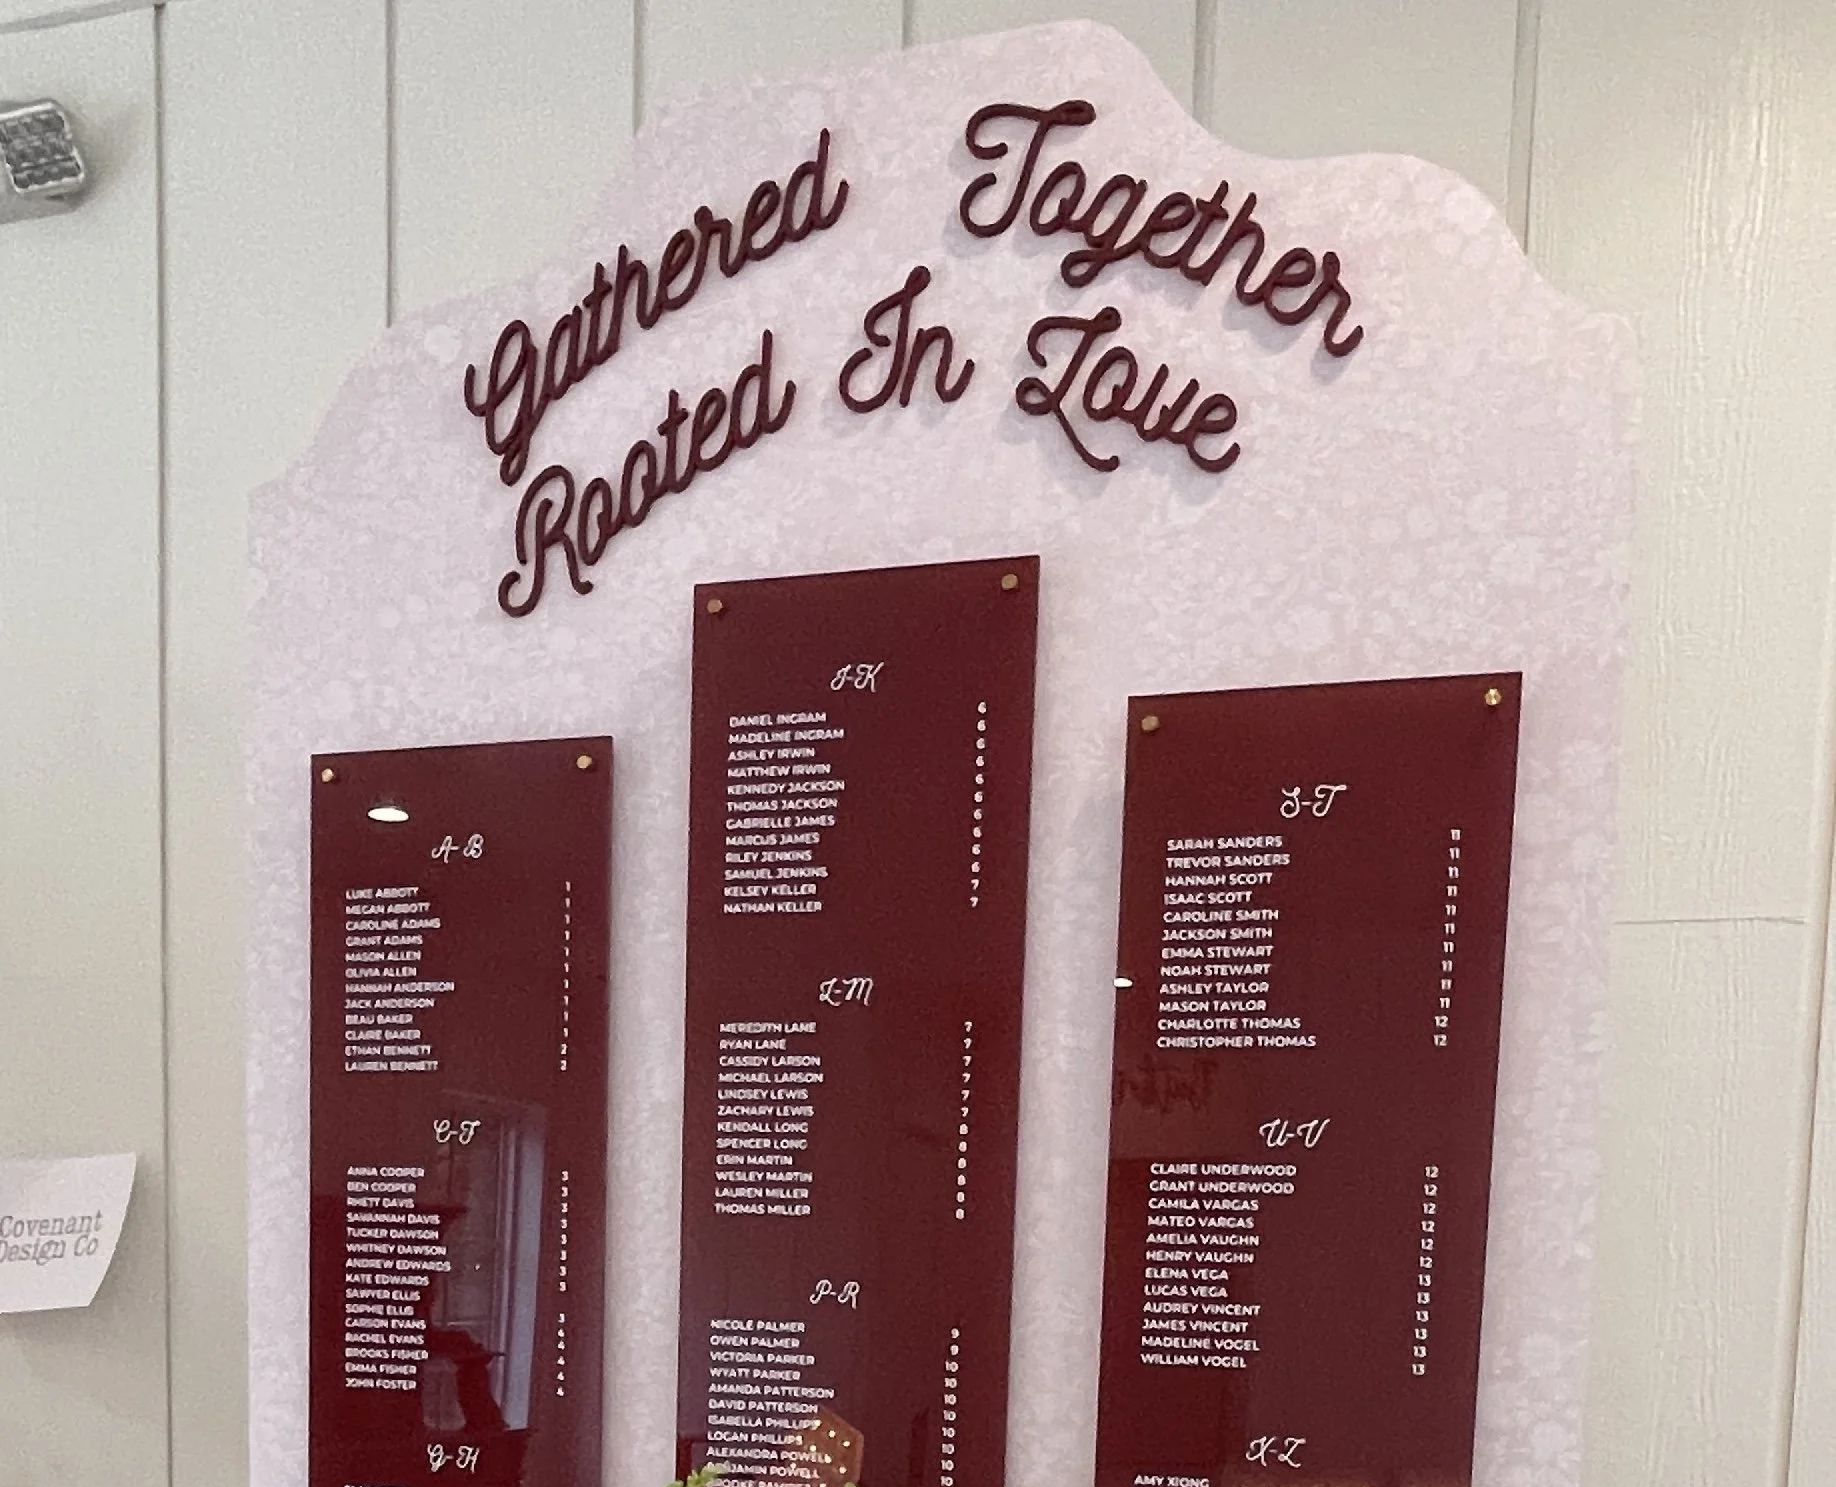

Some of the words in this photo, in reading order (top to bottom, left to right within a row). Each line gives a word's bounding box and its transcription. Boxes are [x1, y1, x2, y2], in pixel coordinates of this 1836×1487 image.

[464, 127, 849, 486] Gathered
[959, 99, 1364, 357] Together
[498, 328, 797, 618] Rooted
[838, 265, 975, 414] In
[1015, 306, 1241, 473] Love
[729, 714, 776, 728] DANIEL
[775, 712, 826, 725] INGRAM
[728, 730, 793, 744] MADELINE
[794, 729, 844, 740] INGRAM
[728, 765, 791, 778] MATTHEW
[792, 764, 831, 776] IRWIN
[727, 782, 787, 795] KENNEDY
[786, 780, 845, 793] JACKSON
[726, 800, 781, 812] THOMAS
[780, 797, 838, 810] JACKSON
[1167, 838, 1214, 851] SARAH
[1217, 836, 1282, 849] SANDERS
[1166, 855, 1222, 869] TREVOR
[1224, 854, 1290, 867] SANDERS
[1165, 874, 1226, 887] HANNAH
[1229, 872, 1273, 886] SCOTT
[724, 884, 771, 897] KELSEY
[770, 884, 816, 896] KELLER
[1164, 892, 1207, 905] ISAAC
[1206, 891, 1253, 904] SCOTT
[724, 902, 774, 913] NATHAN
[776, 901, 822, 912] KELLER
[1163, 910, 1233, 923] CAROLINE
[1236, 909, 1279, 921] SMITH
[1162, 928, 1228, 941] JACKSON
[1229, 927, 1272, 940] SMITH
[720, 1022, 782, 1034] MEREDITH
[784, 1022, 816, 1033] LANE
[1158, 1017, 1238, 1030] CHARLOTTE
[1241, 1017, 1301, 1029] THOMAS
[719, 1038, 752, 1050] RYAN
[754, 1038, 786, 1050] LANE
[1156, 1035, 1254, 1048] CHRISTOPHER
[1256, 1035, 1316, 1047] THOMAS
[718, 1072, 773, 1083] MICHAEL
[774, 1072, 824, 1083] LARSON
[718, 1104, 776, 1116] ZACHARY
[775, 1105, 814, 1117] LEWIS
[717, 1122, 772, 1132] KENDALL
[774, 1122, 808, 1133] LONG
[1150, 1162, 1198, 1175] CLAIRE
[1201, 1164, 1296, 1176] UNDERWOOD
[1149, 1180, 1196, 1192] GRANT
[1198, 1181, 1294, 1194] UNDERWOOD
[714, 1203, 765, 1214] THOMAS
[767, 1204, 810, 1216] MILLER
[1148, 1198, 1200, 1210] CAMILA
[1202, 1199, 1260, 1211] VARGAS
[0, 1209, 104, 1238] Covenant
[1148, 1216, 1196, 1227] MATEO
[1198, 1216, 1254, 1228] VARGAS
[73, 1234, 99, 1257] Co
[1146, 1233, 1201, 1244] AMELIA
[1200, 1234, 1259, 1246] VAUGHN
[1146, 1250, 1194, 1261] HENRY
[1195, 1251, 1254, 1263] VAUGHN
[710, 1319, 755, 1331] NICOLE
[756, 1320, 805, 1332] PALMER
[710, 1335, 751, 1346] OWEN
[750, 1337, 800, 1348] PALMER
[1142, 1336, 1213, 1349] MADELINE
[1214, 1339, 1260, 1351] VOGEL
[710, 1351, 765, 1364] VICTORIA
[767, 1353, 815, 1365] PARKER
[708, 1383, 763, 1396] AMANDA
[762, 1385, 834, 1399] PATTERSON
[709, 1398, 747, 1410] DAVID
[748, 1399, 818, 1414] PATTERSON
